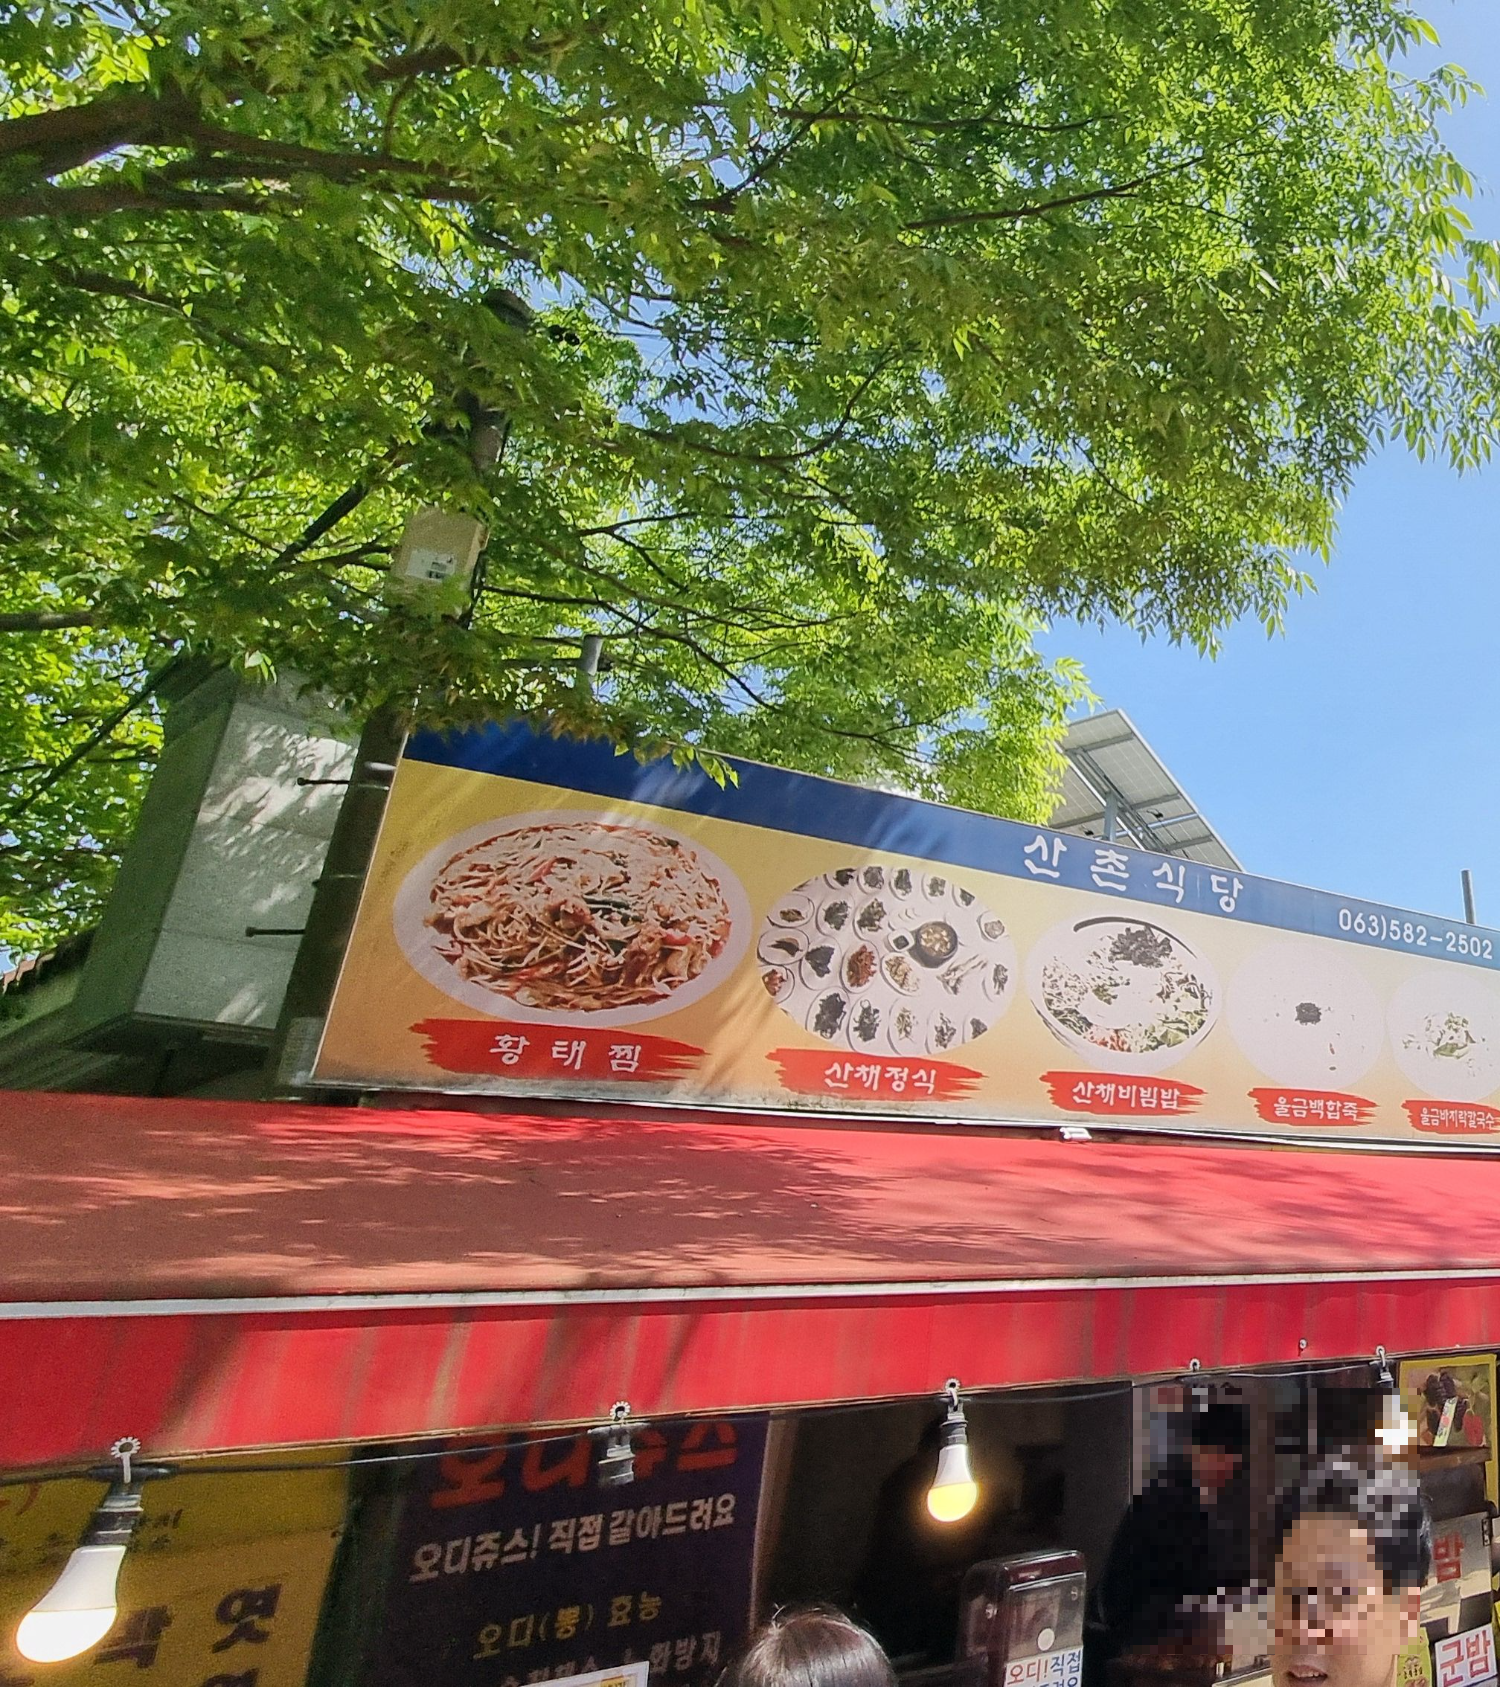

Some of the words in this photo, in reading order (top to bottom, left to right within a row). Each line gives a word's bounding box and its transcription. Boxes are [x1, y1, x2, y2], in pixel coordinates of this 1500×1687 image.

[1024, 834, 1243, 913] 산촌식당
[1338, 908, 1493, 960] 063)582-2502
[489, 1033, 642, 1074] 황태찜
[824, 1061, 937, 1095] 산채정식
[1072, 1081, 1181, 1110] 산채비빔밥
[1273, 1096, 1369, 1121] 울금백합죽
[1420, 1107, 1495, 1131] 울금바지락칼국수
[408, 1524, 541, 1584] 오디쥬스!
[607, 1493, 737, 1546] 갈아드려요
[1007, 1659, 1048, 1685] 오디!
[1050, 1651, 1081, 1677] 직접
[1440, 1629, 1491, 1687] 군밤
